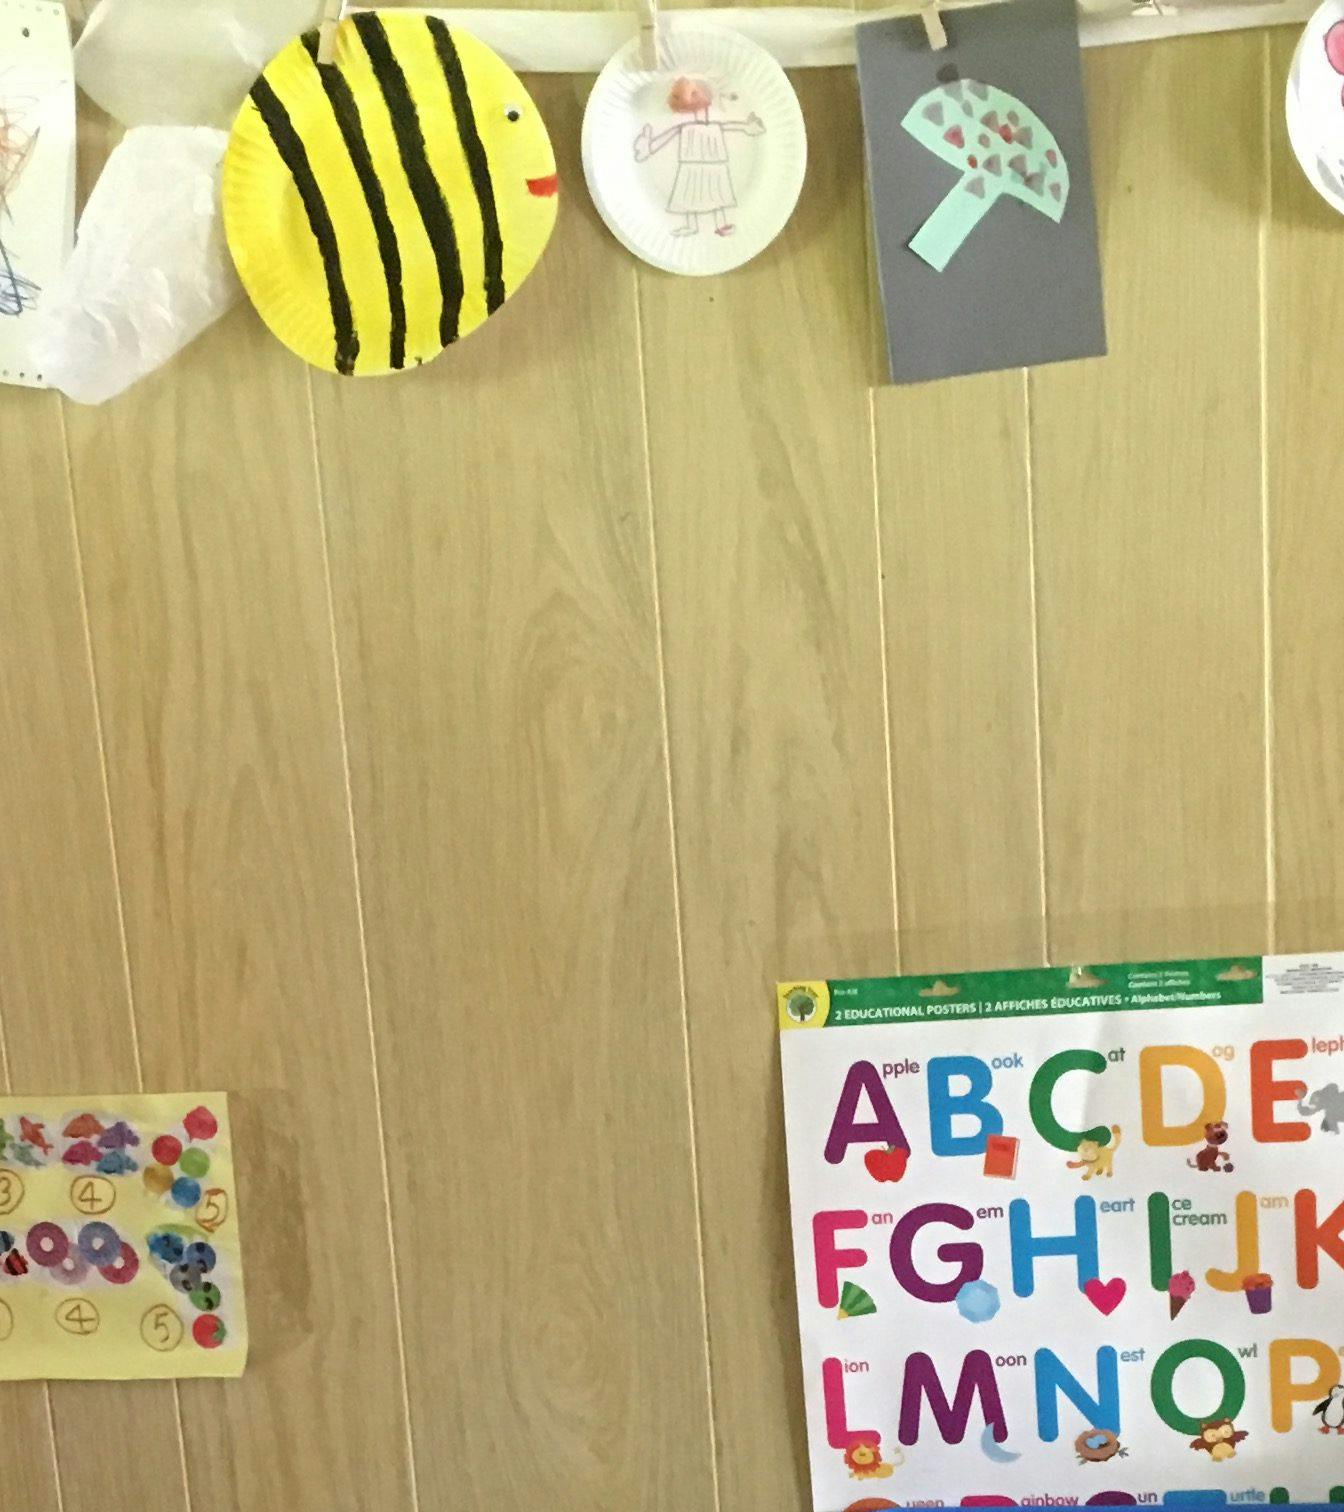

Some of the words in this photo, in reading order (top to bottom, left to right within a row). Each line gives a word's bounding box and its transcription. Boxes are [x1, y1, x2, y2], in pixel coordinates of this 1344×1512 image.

[845, 1006, 925, 1020] EDUCATIONAL
[927, 1003, 977, 1015] POSTERS
[995, 999, 1048, 1011] AFFICHES
[1173, 1211, 1228, 1226] cream
